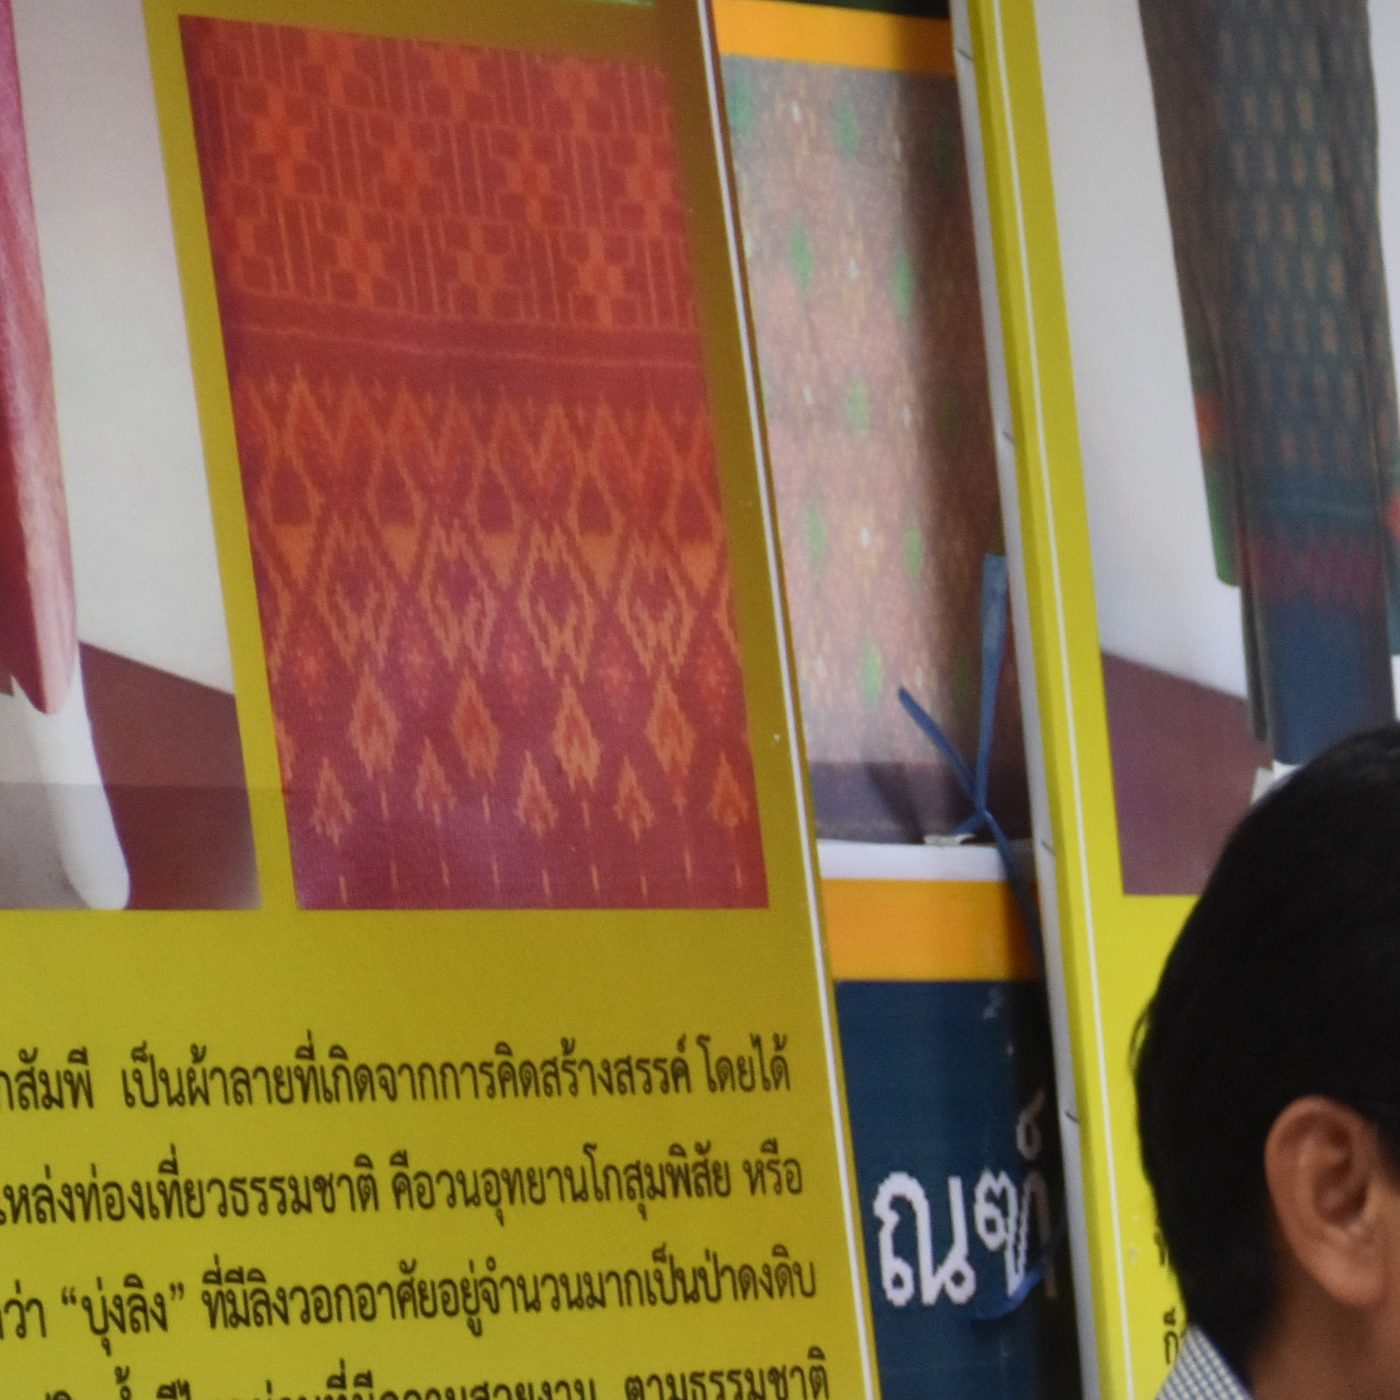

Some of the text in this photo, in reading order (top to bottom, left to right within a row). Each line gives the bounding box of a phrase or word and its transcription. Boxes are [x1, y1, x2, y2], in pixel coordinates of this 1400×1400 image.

[120, 1028, 692, 1109] เป็นผ้าลายที่เกิดจากการคิดสร้างสรรค์
[696, 1031, 791, 1094] โดยได้
[0, 1137, 805, 1227] หล่งท่องเที่ยวธรรมชาติ คือวนอุทยานโกสุมพิสัย หรือ
[0, 1278, 48, 1340] ว่า
